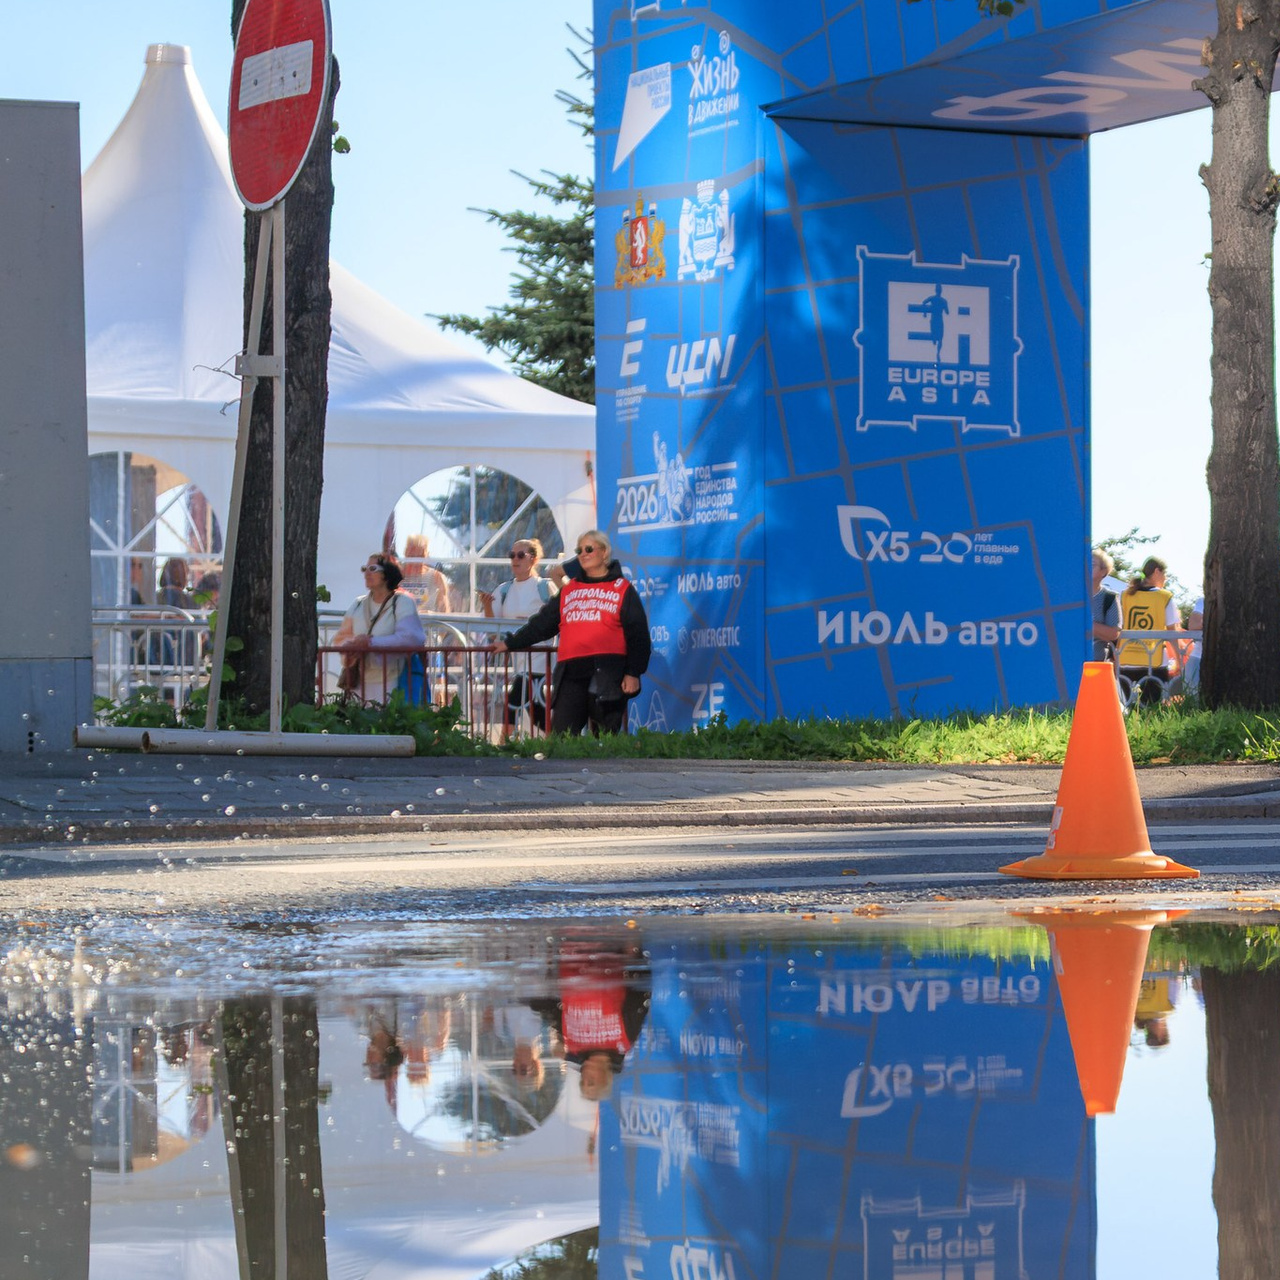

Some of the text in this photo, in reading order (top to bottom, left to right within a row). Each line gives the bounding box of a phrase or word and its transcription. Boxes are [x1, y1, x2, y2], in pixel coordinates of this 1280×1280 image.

[687, 49, 740, 99] ЖИЗНЬ
[694, 92, 740, 124] ДВИЖЕНИИ
[888, 281, 991, 365] EA
[888, 367, 991, 386] EUROPE
[887, 386, 991, 405] ASIA
[695, 465, 711, 479] ГОД
[695, 477, 738, 494] ЕДИНСТВА
[617, 484, 659, 524] 2026
[696, 492, 734, 509] НАРОДОВ
[696, 508, 729, 524] РОССИИ
[975, 533, 993, 542] лет
[975, 544, 1019, 553] главные
[975, 555, 1003, 564] в еде
[678, 572, 714, 594] ИЮЛЬ
[717, 574, 741, 590] авто
[566, 609, 601, 622] СЛУЖБА
[691, 626, 740, 649] SYNERGETIC
[818, 610, 1038, 646] ИЮЛЬ авто
